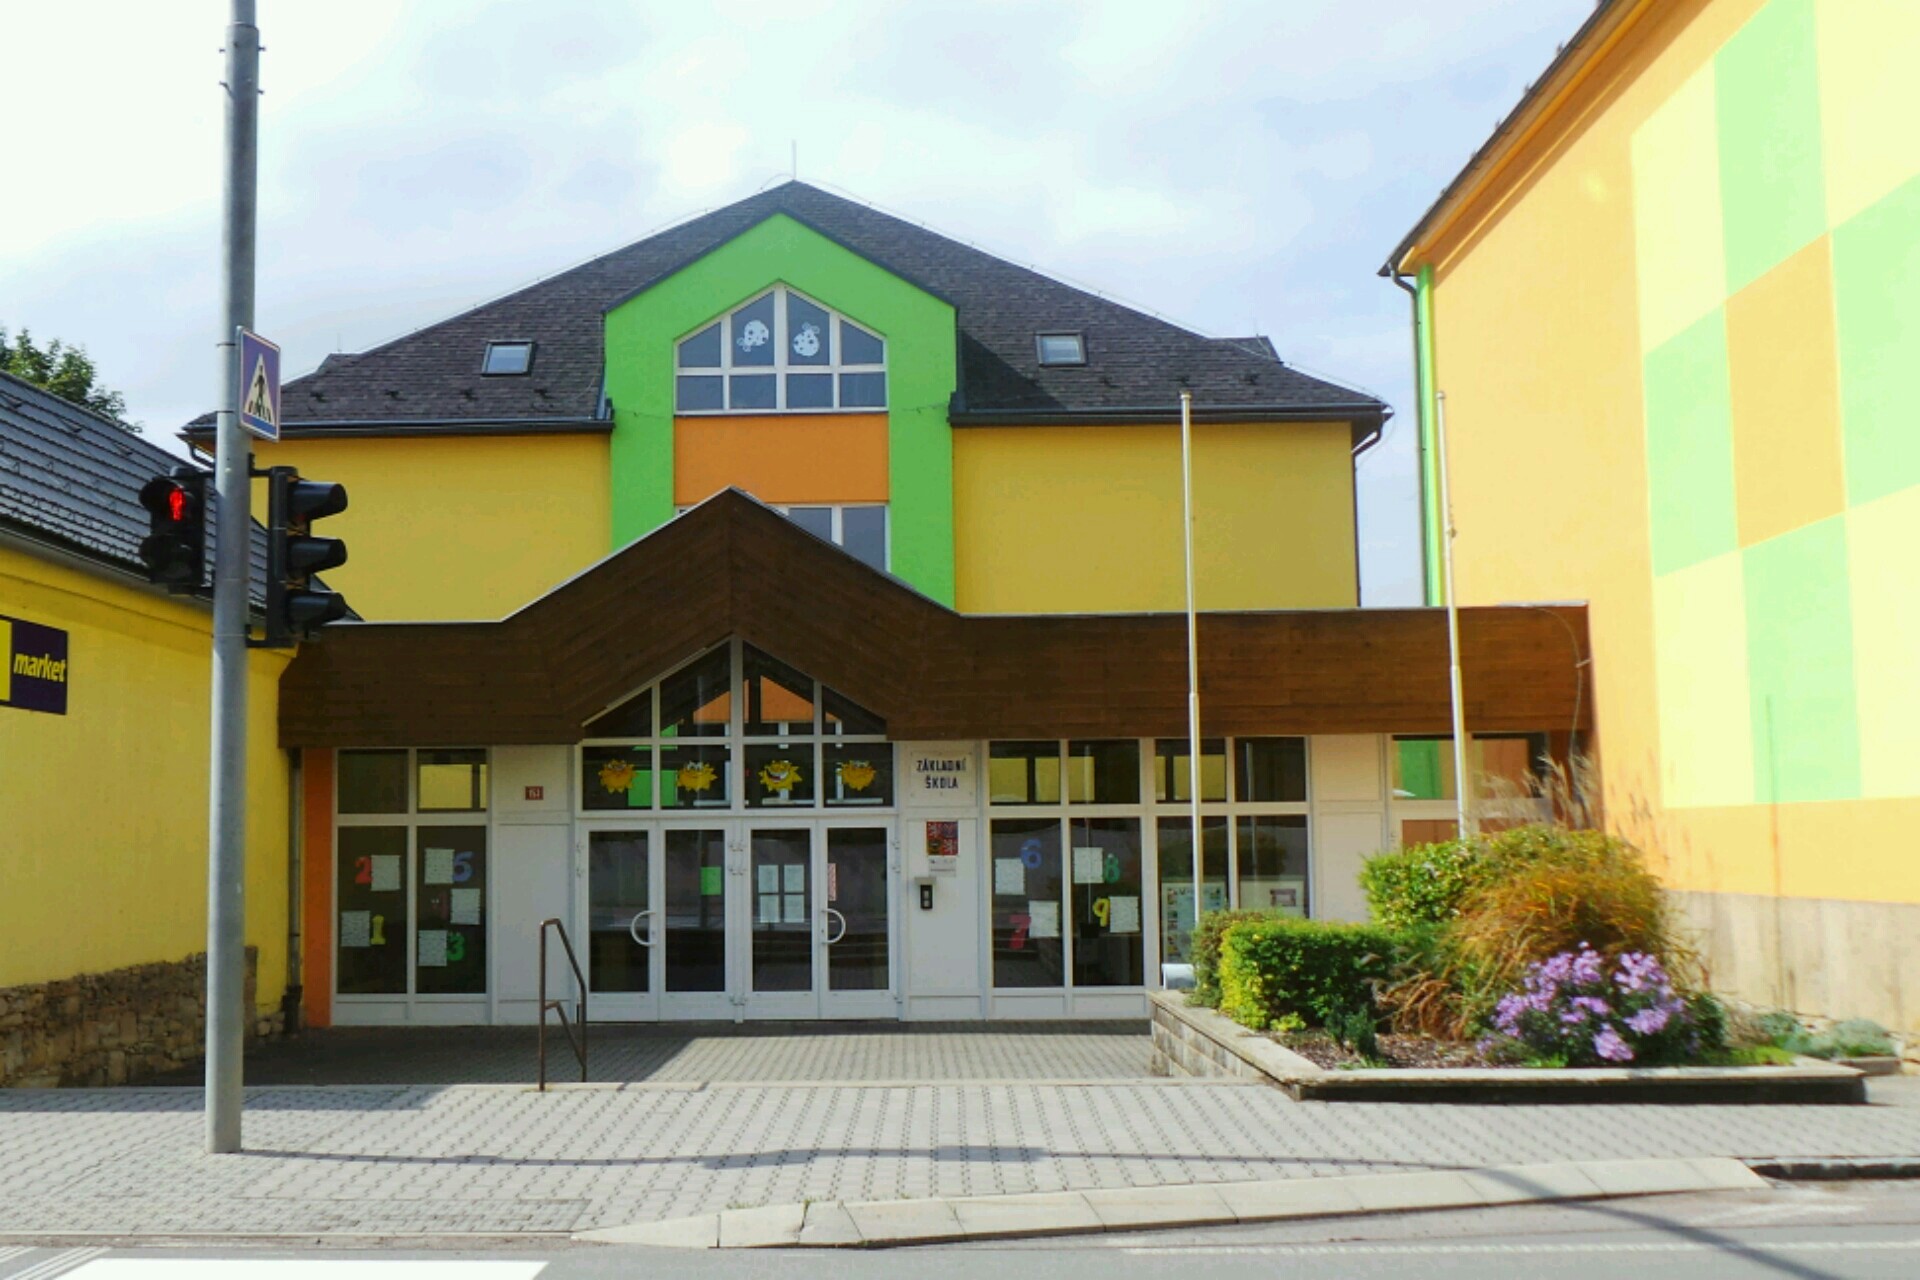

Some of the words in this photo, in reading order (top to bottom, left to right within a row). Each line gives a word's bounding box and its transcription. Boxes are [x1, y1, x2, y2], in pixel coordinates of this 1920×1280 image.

[14, 653, 65, 682] market
[916, 757, 966, 771] ZÁKLADNÍ
[926, 775, 959, 789] ŠKOLA
[1021, 838, 1041, 868] 6
[355, 855, 372, 884] 2
[1104, 853, 1120, 883] 8
[1092, 898, 1110, 927] 9
[371, 914, 385, 945] 1
[1009, 913, 1031, 949] 7
[446, 932, 465, 961] 3
